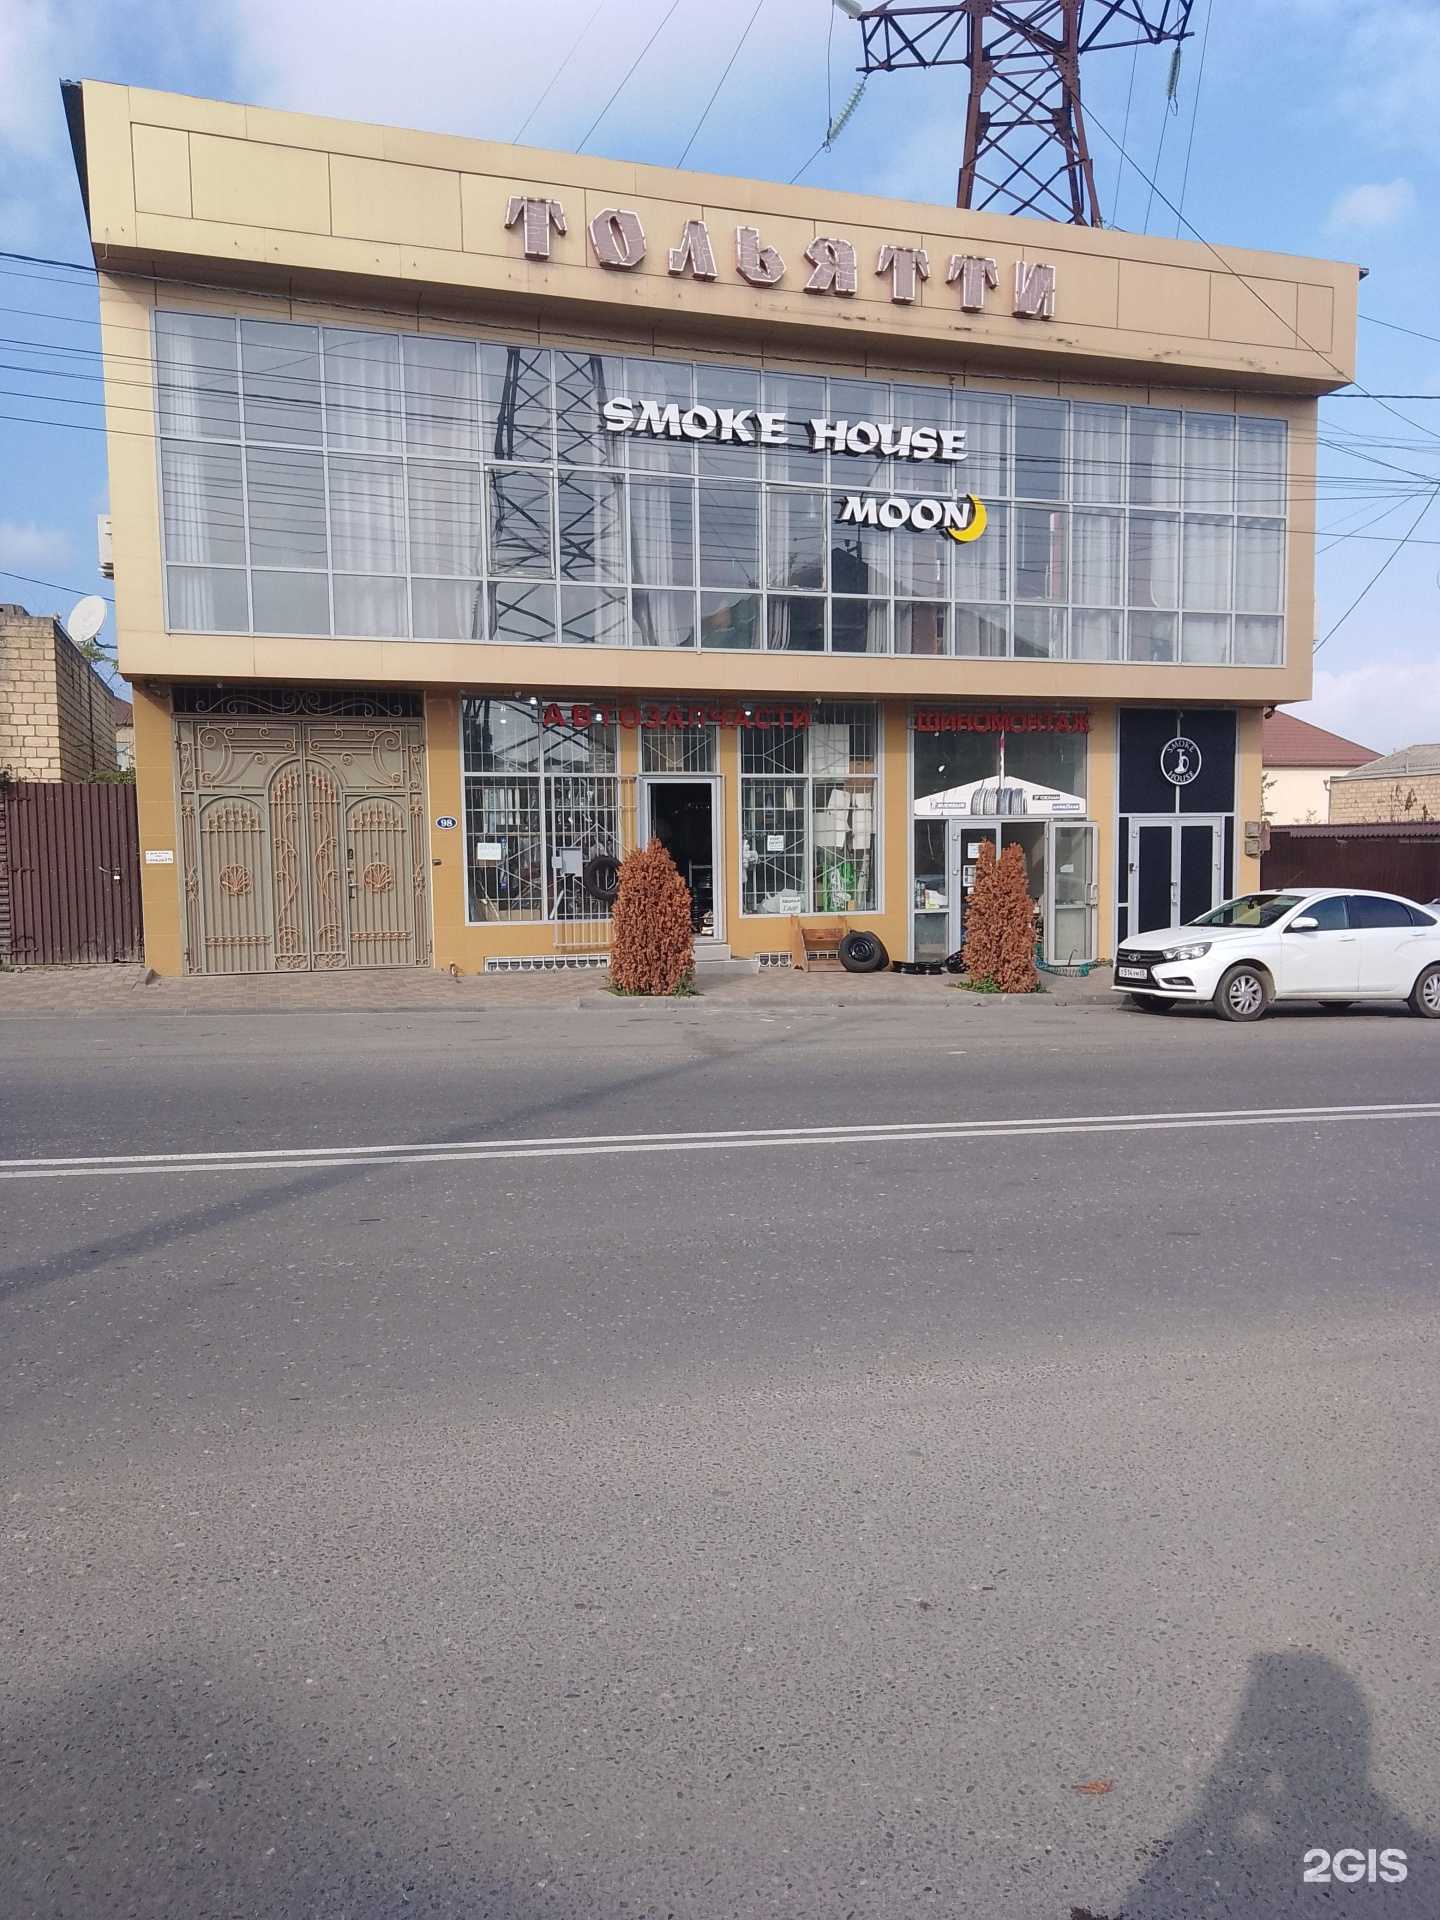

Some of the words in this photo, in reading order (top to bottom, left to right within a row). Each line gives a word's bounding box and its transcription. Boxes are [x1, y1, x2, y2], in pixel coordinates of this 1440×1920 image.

[504, 195, 1057, 319] ТОЛЬЯТТИ
[602, 396, 790, 445] SMOKE
[808, 418, 969, 462] HOUSE
[841, 495, 970, 530] MOON
[543, 703, 811, 729] АВТОЗАПЧАСТИ
[916, 711, 1089, 733] ШИНОМОНТАЖ
[440, 818, 454, 828] 98
